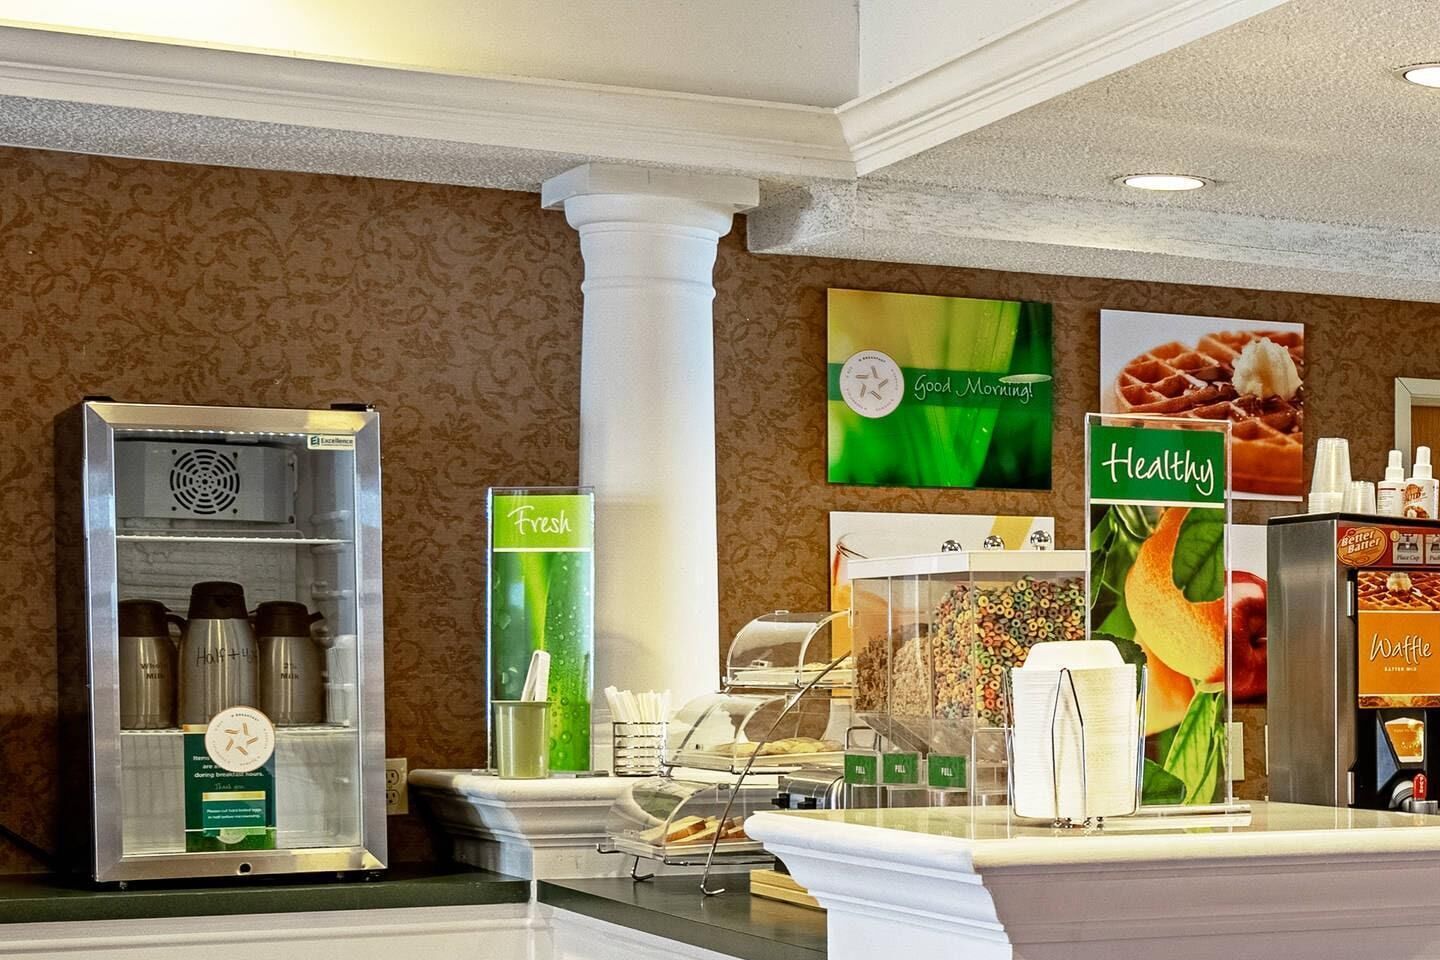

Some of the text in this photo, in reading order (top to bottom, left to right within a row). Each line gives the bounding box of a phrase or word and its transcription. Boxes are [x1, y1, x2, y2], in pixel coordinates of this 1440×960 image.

[914, 374, 951, 401] Good
[955, 376, 1034, 405] Morning!
[1101, 442, 1215, 497] Healthy
[507, 505, 573, 536] Fresh
[1341, 530, 1376, 547] Better
[1347, 537, 1382, 554] Batter
[196, 647, 226, 667] Half
[1369, 633, 1433, 665] Waffle
[855, 766, 866, 775] PULL
[895, 764, 906, 774] PULL
[941, 767, 953, 777] PULL
